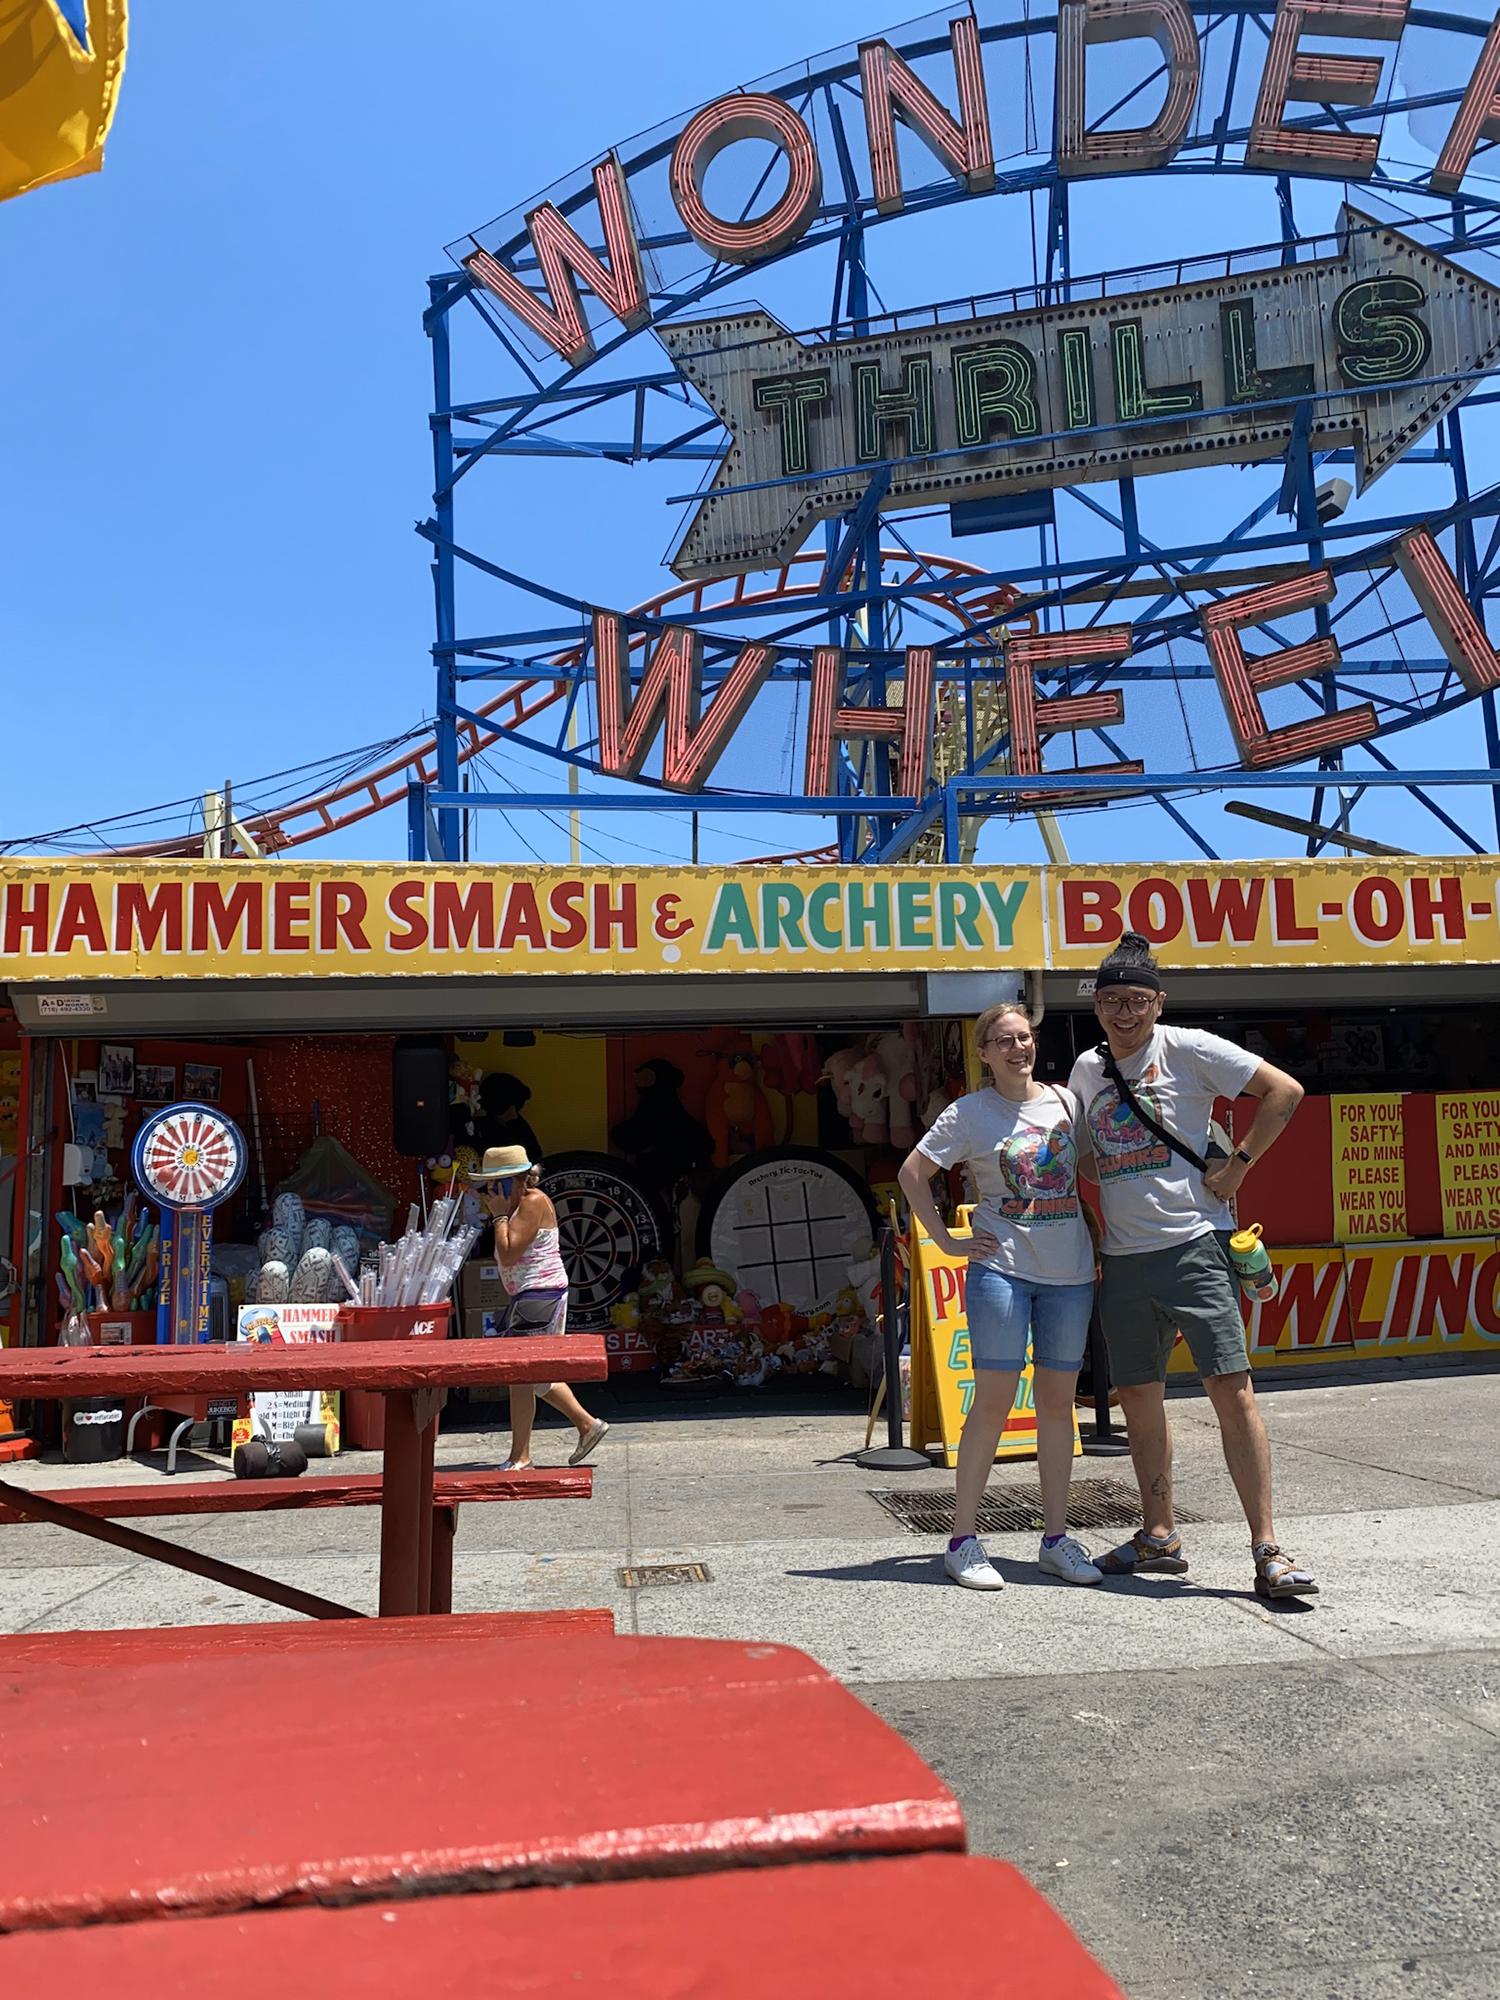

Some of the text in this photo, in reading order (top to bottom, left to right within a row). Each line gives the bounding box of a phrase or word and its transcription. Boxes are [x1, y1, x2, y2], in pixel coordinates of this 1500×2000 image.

[752, 274, 1434, 477] THRILLS
[2, 881, 372, 955] HAMMER
[387, 880, 638, 953] SMASH
[653, 892, 695, 963] &
[702, 880, 1029, 953] ARCHERY
[1340, 1104, 1366, 1122] FOR
[1441, 1102, 1469, 1120] FOR
[1350, 1125, 1399, 1142] SAFTY
[1341, 1147, 1369, 1161] AND
[1445, 1144, 1475, 1158] AND
[1348, 1167, 1400, 1184] PLEASE
[1453, 1163, 1500, 1181] PLEAS
[1340, 1191, 1375, 1211] WEAR
[1444, 1188, 1483, 1207] WEAR
[1349, 1213, 1406, 1235] MASK
[160, 1240, 172, 1305] PRIZE
[282, 1308, 338, 1322] HAMMER
[289, 1330, 336, 1344] SMASH
[409, 1320, 435, 1336] ACE
